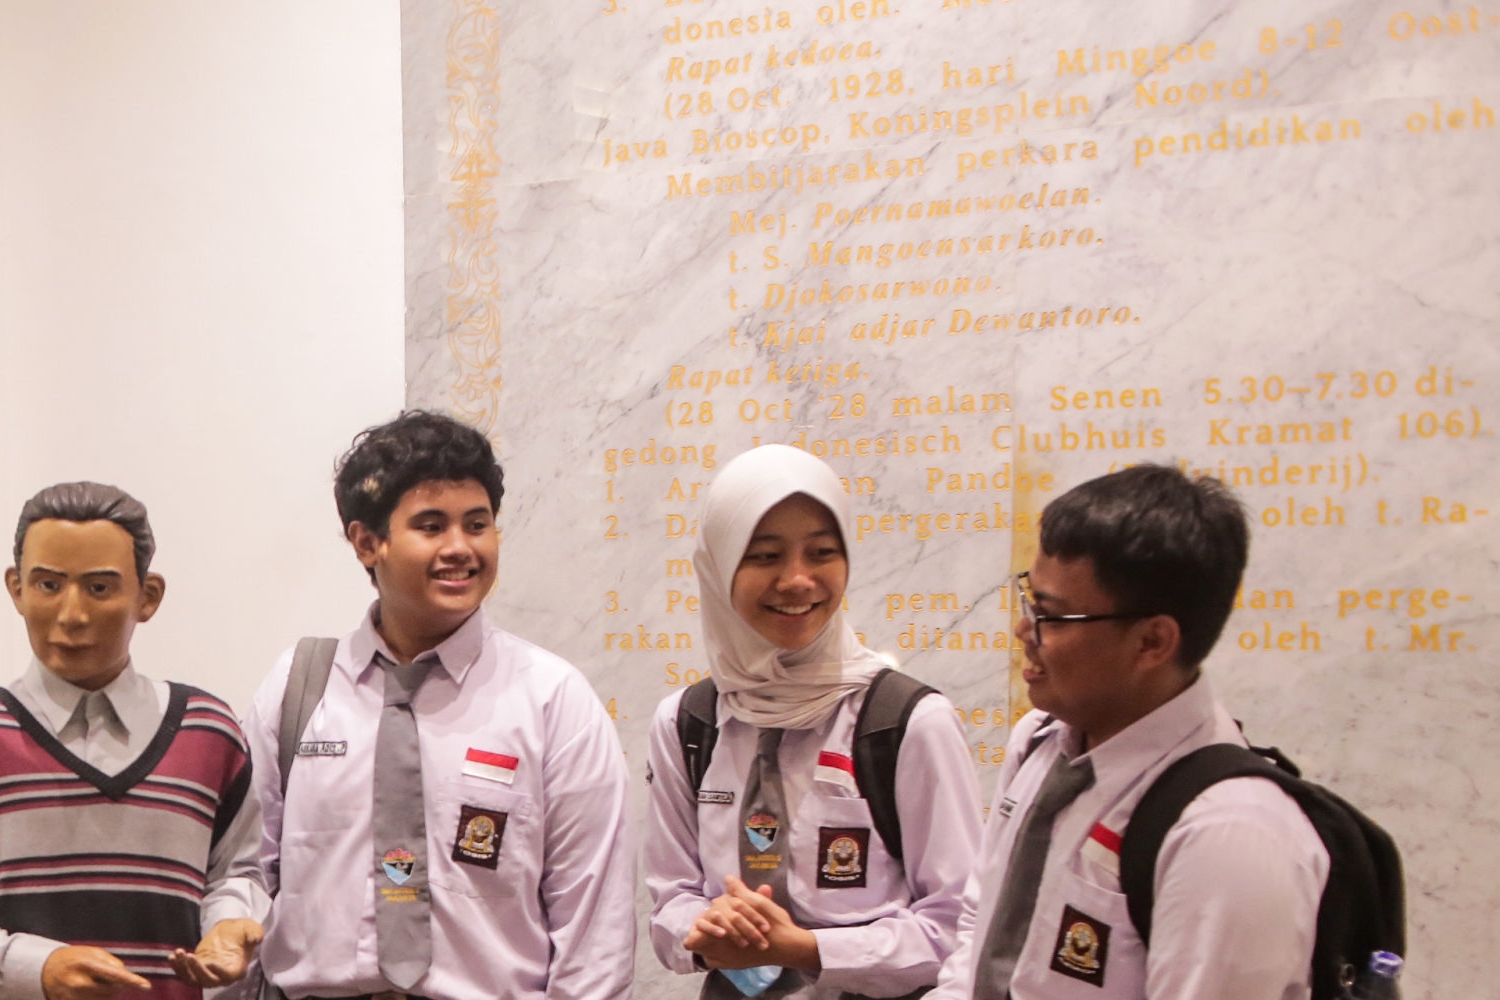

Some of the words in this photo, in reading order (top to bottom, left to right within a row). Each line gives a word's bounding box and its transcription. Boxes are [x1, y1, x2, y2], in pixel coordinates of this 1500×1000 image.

[664, 11, 792, 43] donesia
[665, 91, 712, 120] (28
[727, 86, 791, 112] Oct.
[942, 56, 1016, 89] hari
[1056, 40, 1217, 76] Minggoe
[1258, 20, 1343, 54] 8-12
[666, 53, 752, 84] Rapat
[849, 92, 1090, 139] Koningsplein
[667, 153, 925, 199] Membitjarakan
[957, 139, 1099, 180] perkara
[1134, 114, 1362, 166] pendidikan
[1405, 98, 1495, 133] oleh
[764, 246, 790, 270] S.
[764, 319, 827, 352] Kjai
[851, 313, 936, 345] adjar
[666, 365, 753, 395] Rapat
[766, 357, 870, 388] ketiga.
[665, 400, 714, 429] (28
[892, 386, 1012, 416] malam
[1050, 386, 1162, 411] Senen
[1415, 366, 1475, 396] di-
[604, 439, 717, 473] gedong
[991, 422, 1166, 452] Clubhuis
[1208, 418, 1354, 445] Kramat
[605, 480, 624, 502] 1.
[925, 464, 1054, 492] Pandoe
[604, 515, 628, 538] 2.
[857, 504, 1042, 541] pergeraka
[1262, 497, 1345, 527] oleh
[1421, 497, 1489, 524] Ra-
[605, 591, 628, 613] 3.
[886, 592, 970, 620] pem.
[1338, 589, 1471, 618] perge-
[605, 625, 692, 650] rakan
[1239, 622, 1321, 650] oleh
[1410, 625, 1475, 651] Mr.
